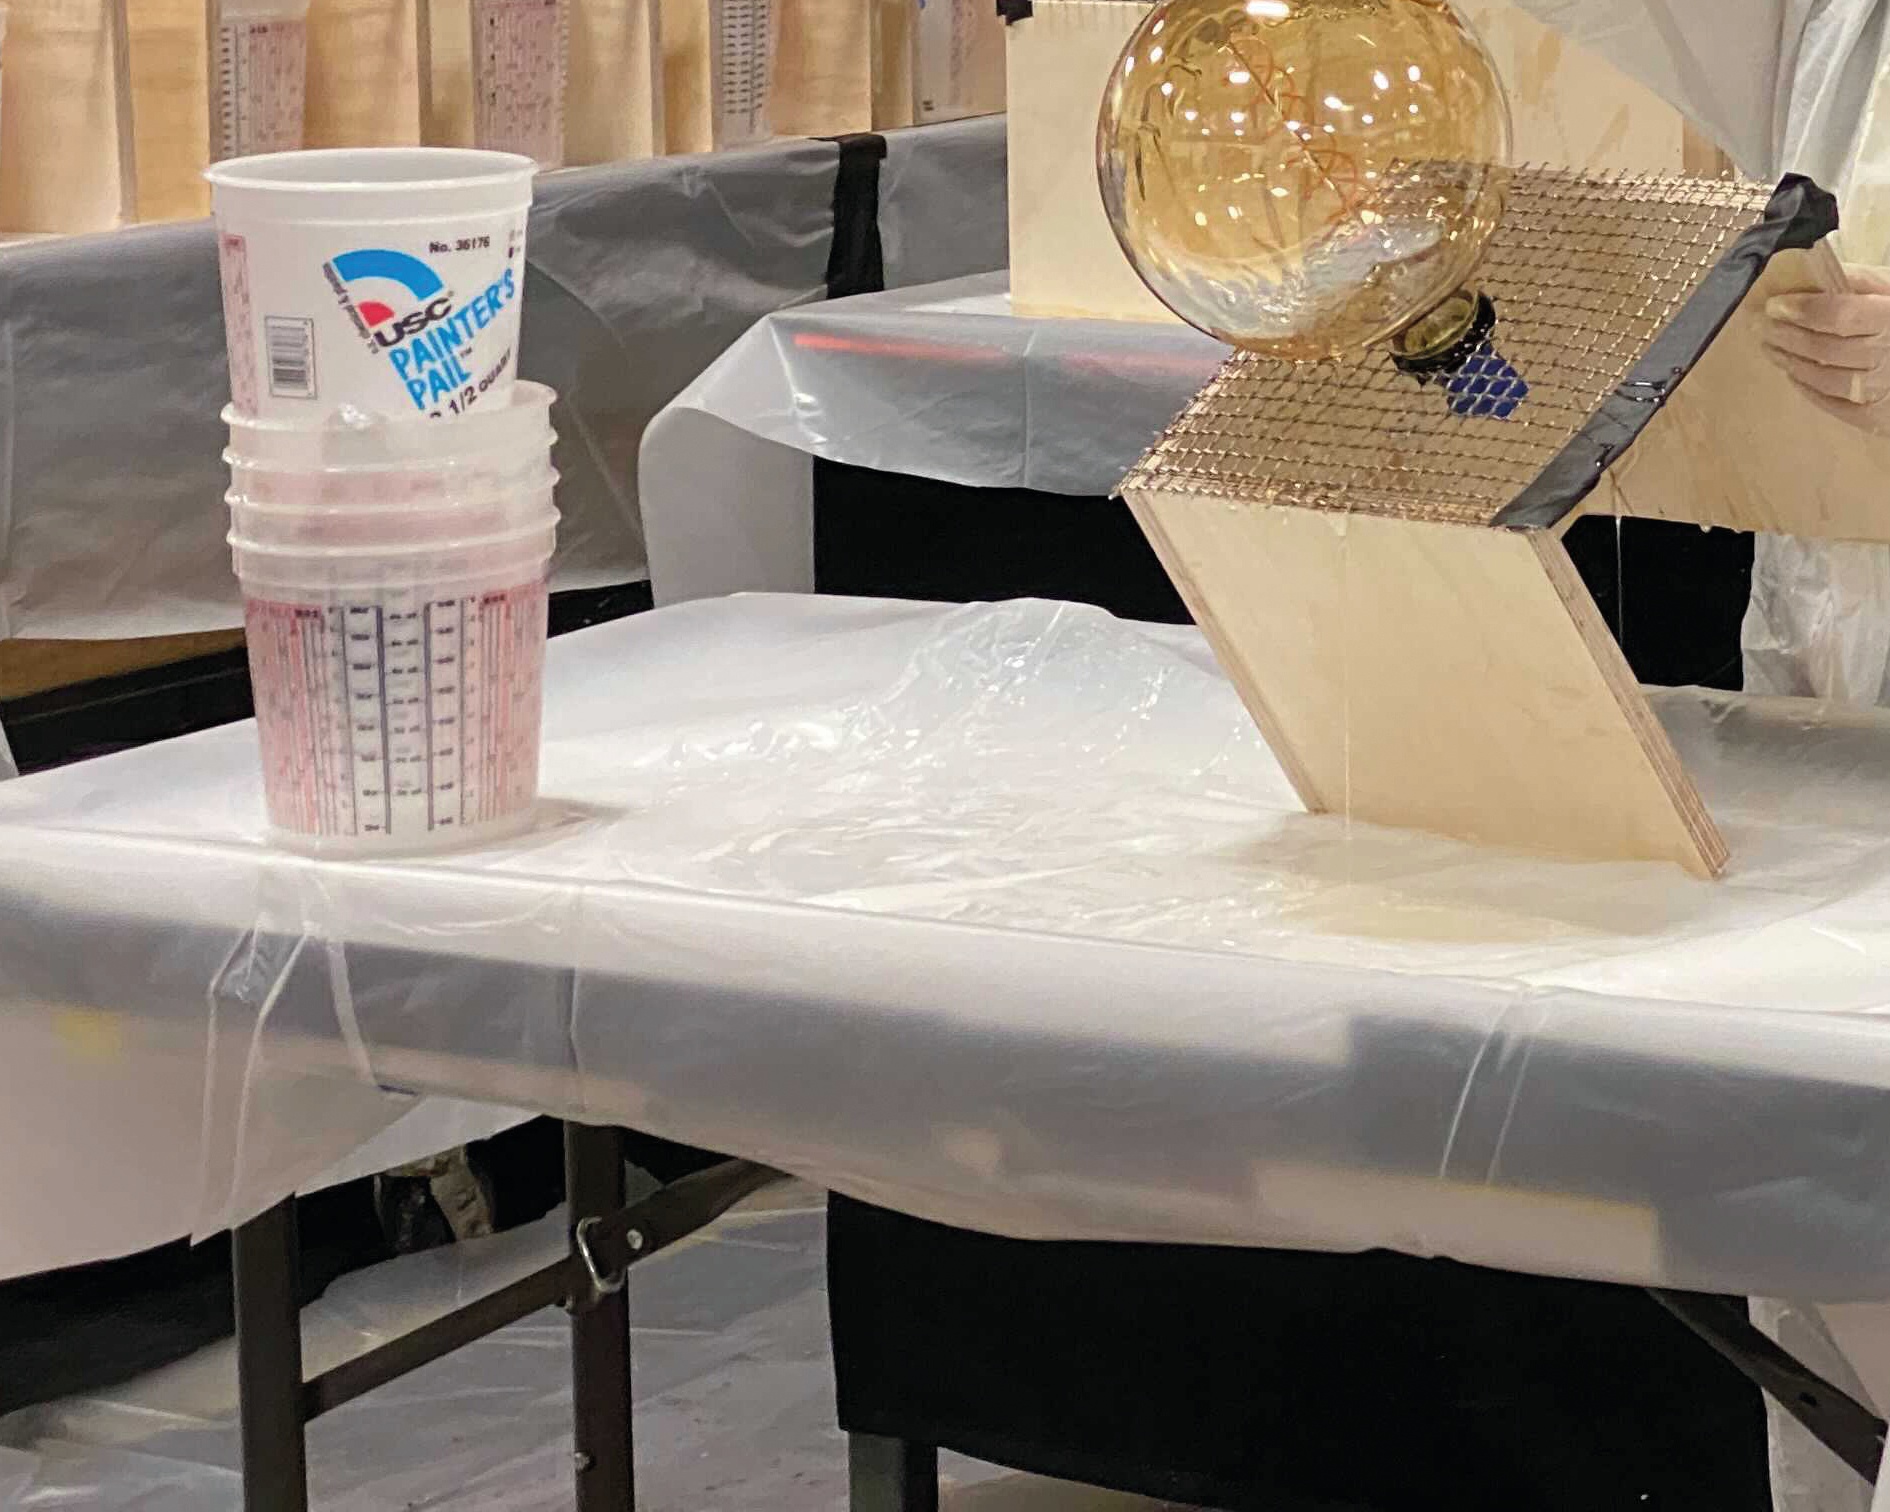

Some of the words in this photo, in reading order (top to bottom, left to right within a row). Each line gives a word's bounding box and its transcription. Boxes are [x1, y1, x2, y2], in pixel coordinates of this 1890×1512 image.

[429, 241, 452, 253] No.
[374, 296, 452, 348] USC
[407, 354, 473, 411] PAIL
